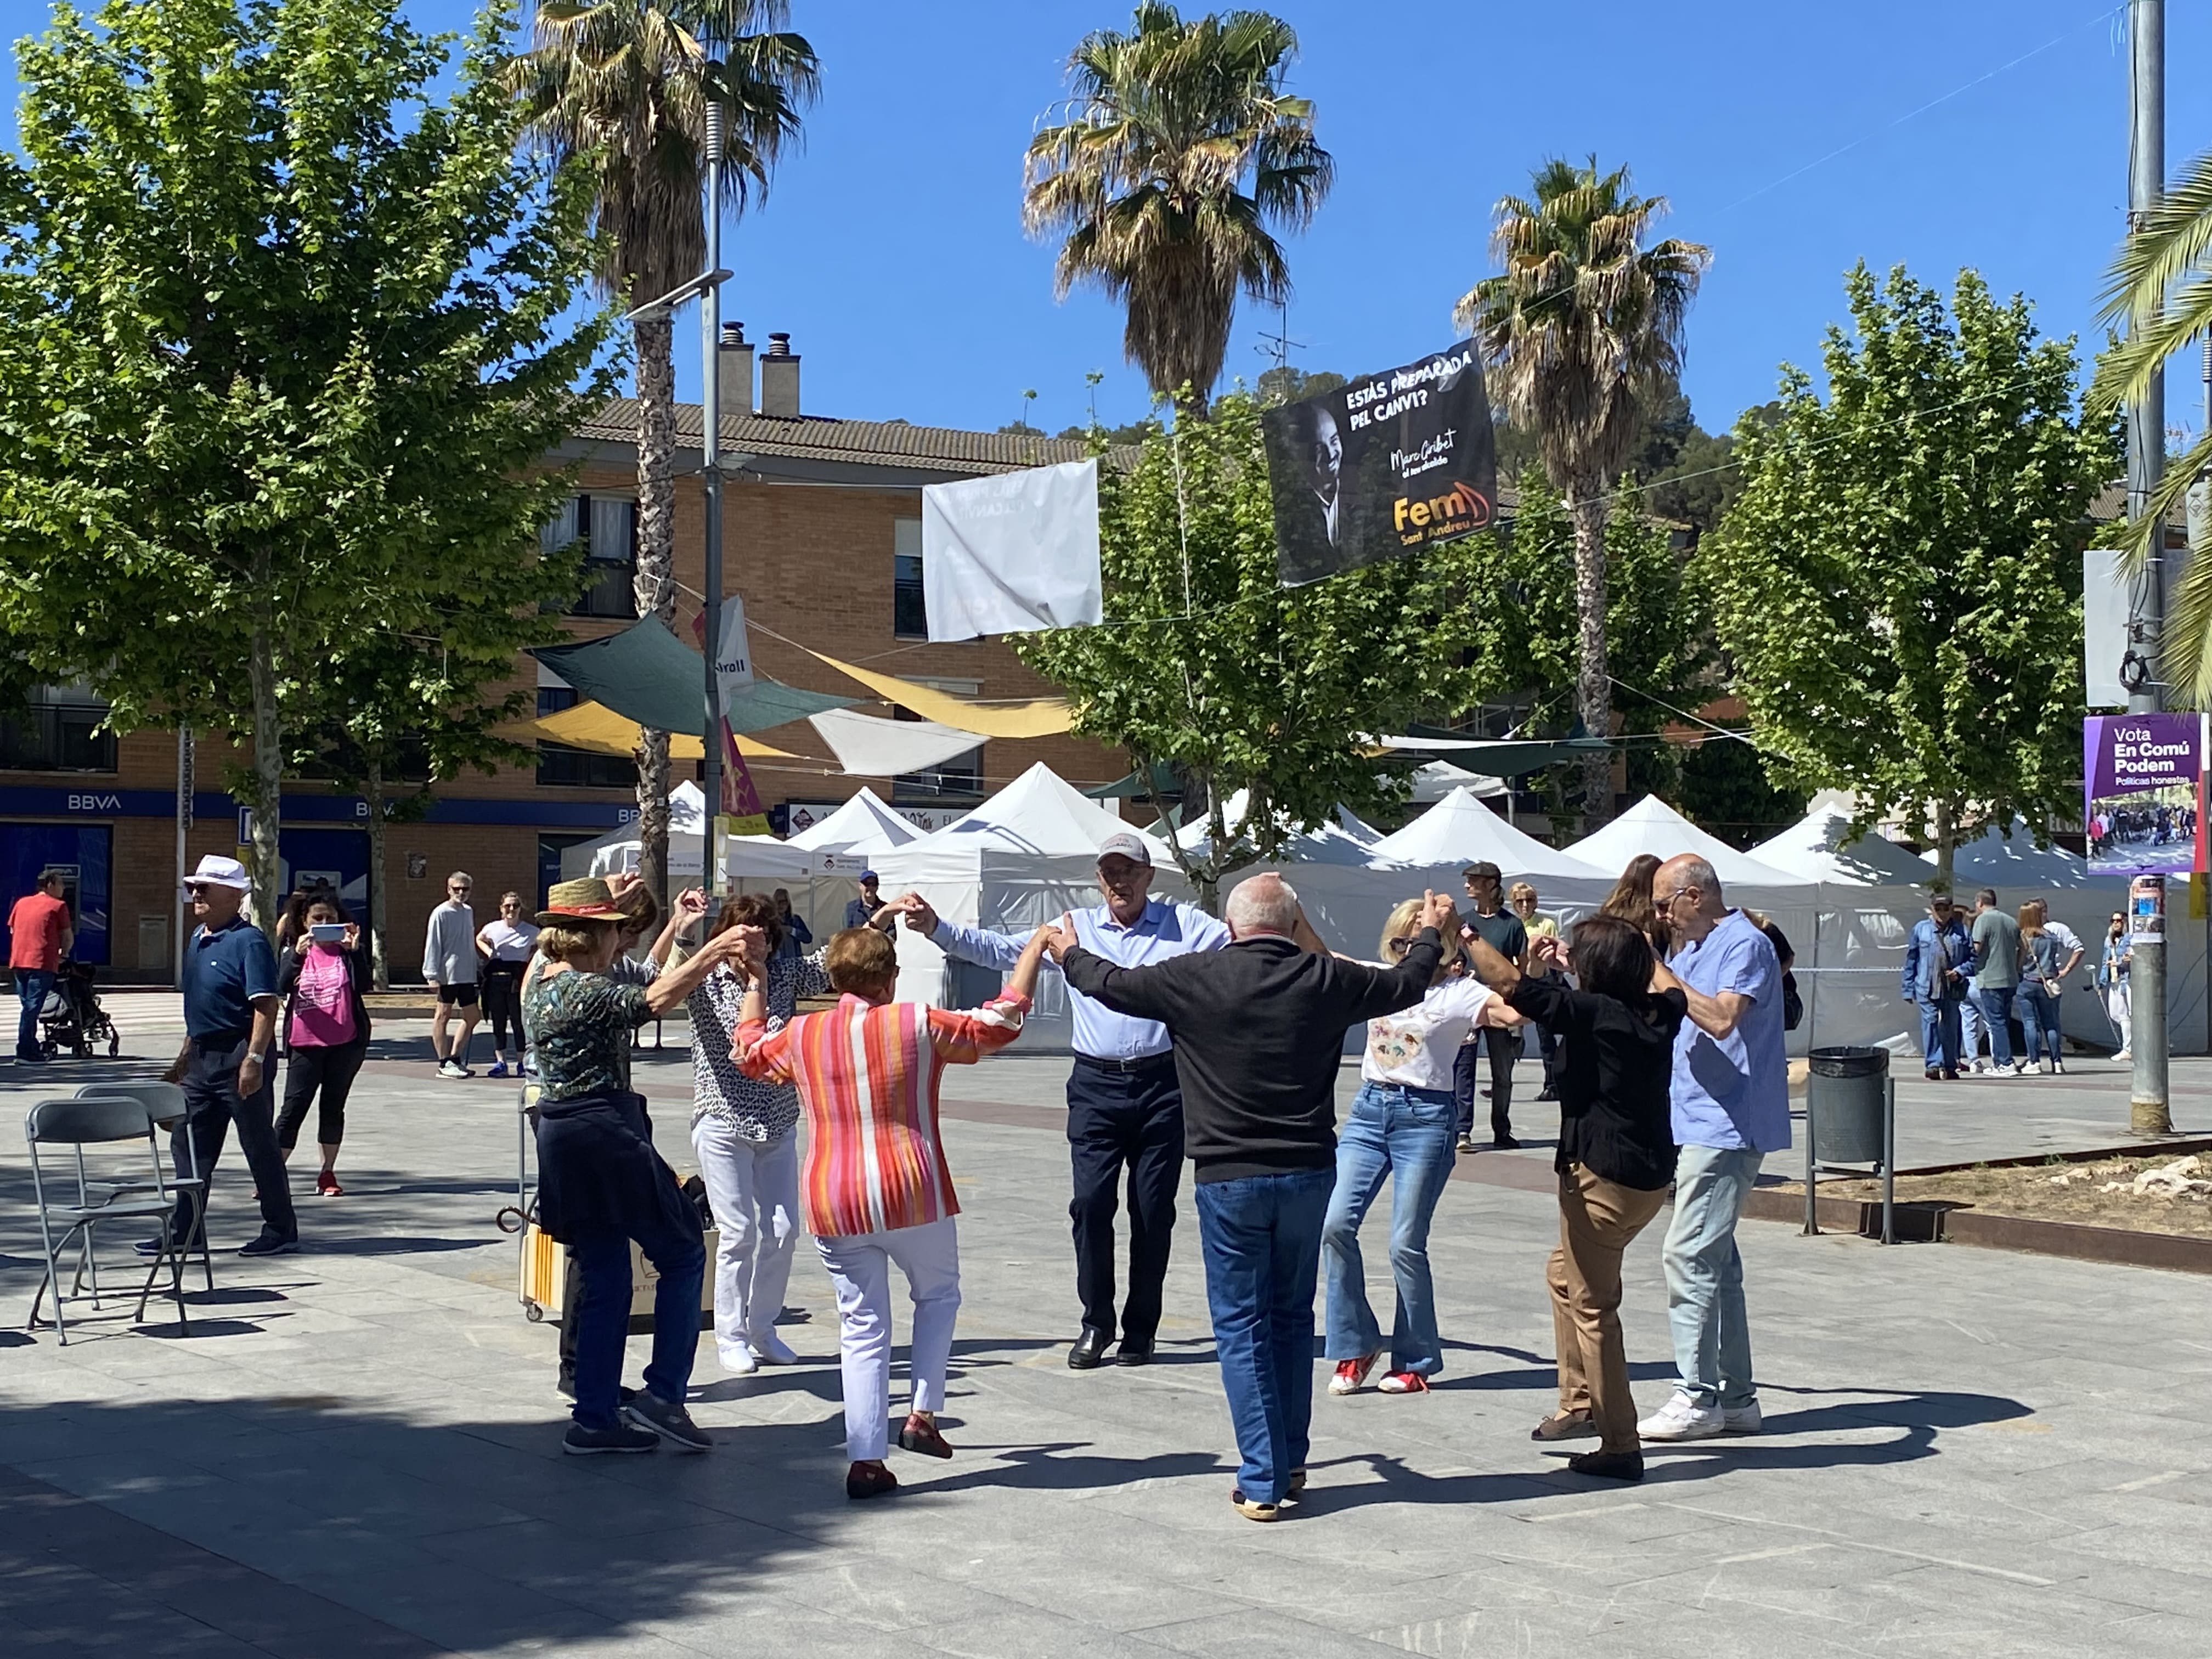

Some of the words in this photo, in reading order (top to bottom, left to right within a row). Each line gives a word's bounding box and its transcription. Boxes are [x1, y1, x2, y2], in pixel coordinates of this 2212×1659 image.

[1391, 351, 1472, 394] PREPARADA
[1350, 410, 1372, 431] PEL
[1374, 390, 1427, 421] CANVI?
[1394, 492, 1466, 532] Fem
[1401, 532, 1423, 546] Sant
[1428, 521, 1470, 538] Andreu
[2114, 727, 2152, 742] Vota
[2114, 743, 2137, 757] En
[2140, 741, 2190, 757] Comú
[2114, 759, 2175, 774] Podem
[69, 794, 122, 810] BBVA
